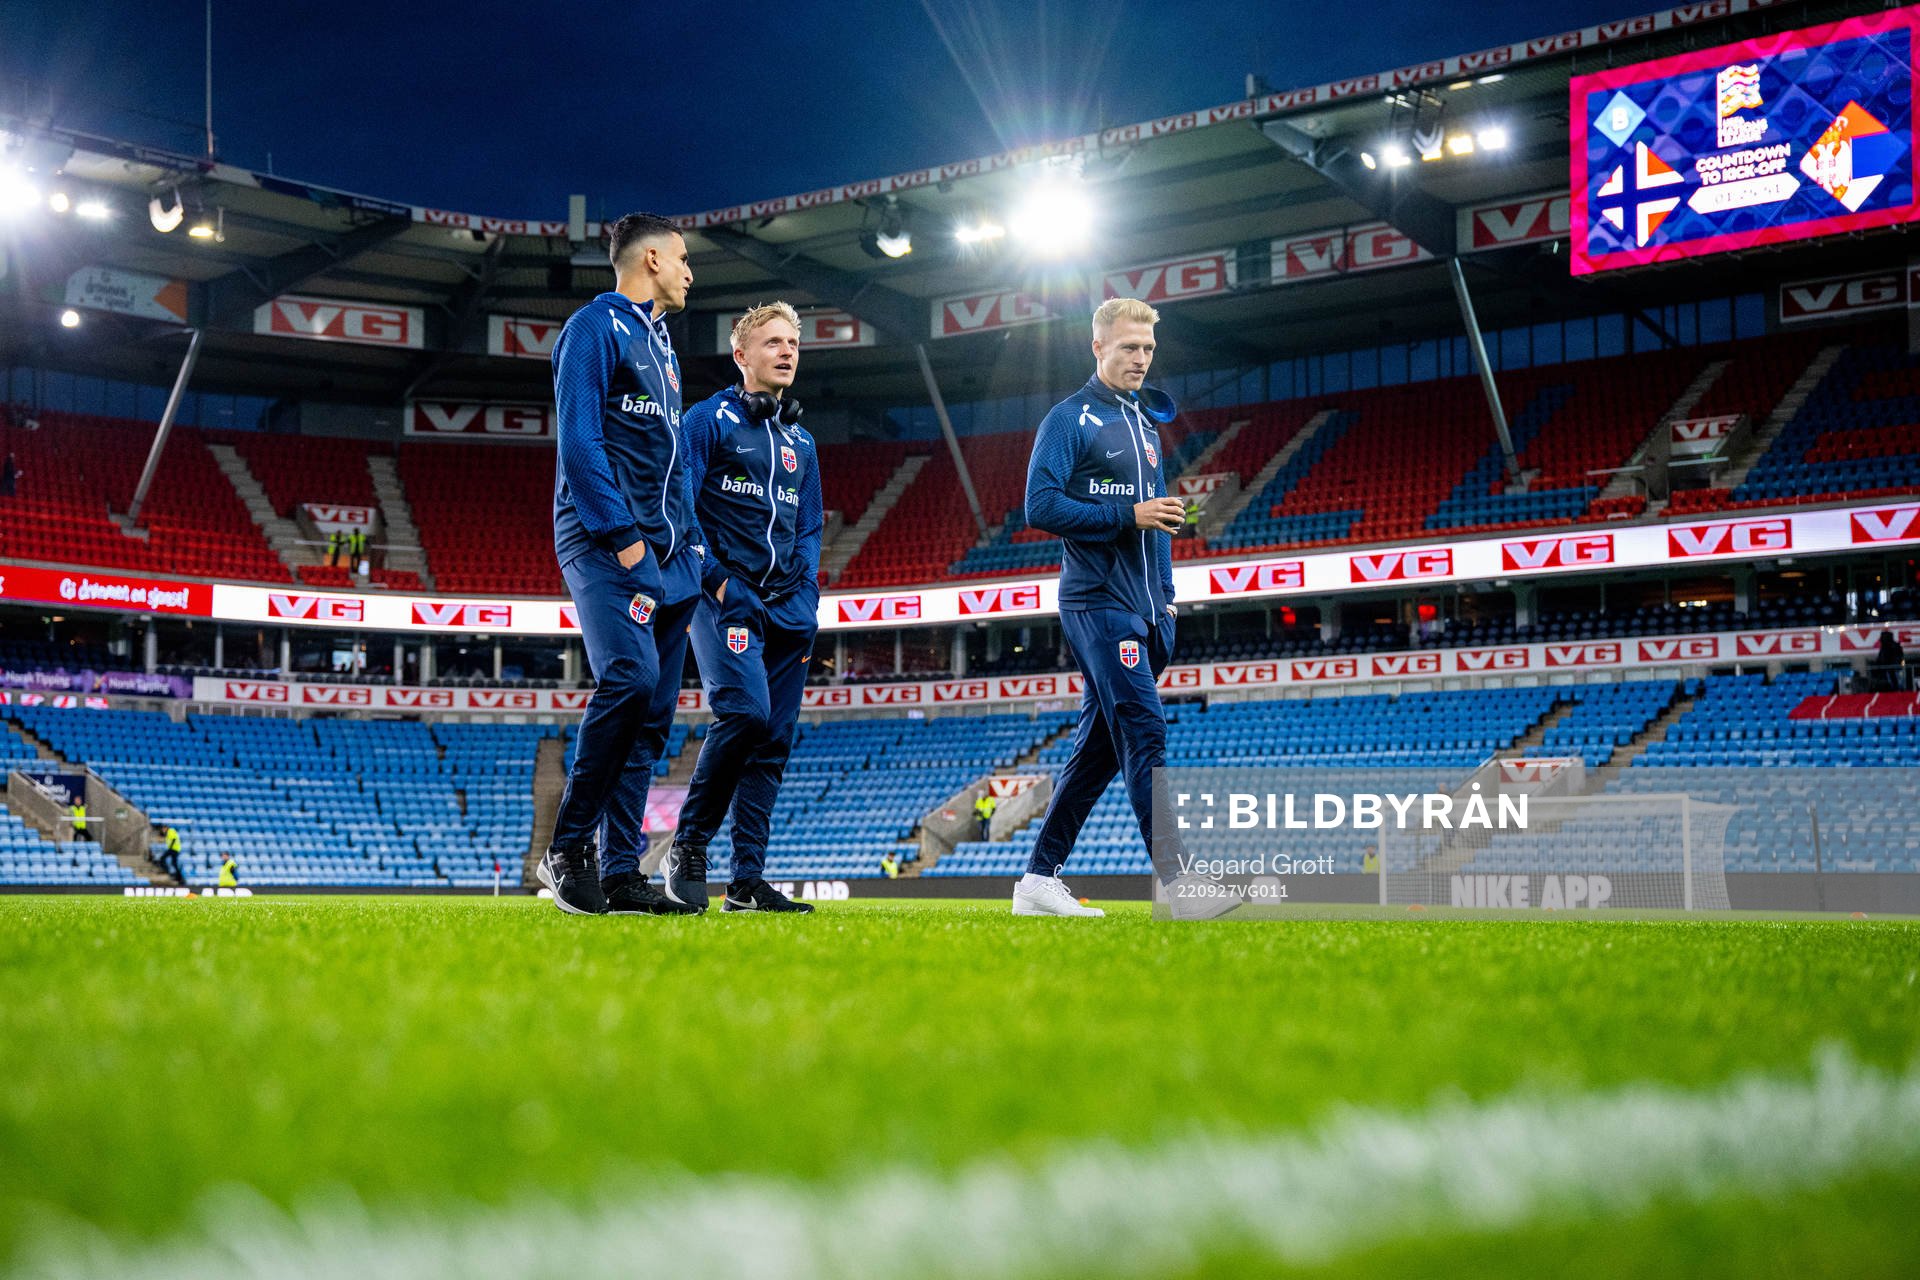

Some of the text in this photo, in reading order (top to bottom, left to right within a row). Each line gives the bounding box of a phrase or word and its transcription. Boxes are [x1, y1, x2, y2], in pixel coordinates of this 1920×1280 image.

[1673, 0, 1732, 24] VG
[1599, 16, 1654, 40] VG
[1527, 32, 1582, 57] VG
[1459, 48, 1511, 71] VG
[1394, 60, 1444, 85] VG
[1330, 76, 1379, 99] VG
[1268, 89, 1317, 110] VG
[1209, 101, 1255, 122] VG
[1612, 107, 1630, 131] B
[1152, 113, 1197, 134] VG
[1098, 125, 1140, 146] VG
[1695, 143, 1791, 172] COUNTDOWN
[891, 171, 930, 189] VG
[941, 160, 980, 179] VG
[1701, 157, 1786, 186] TO KICK-OFF
[797, 190, 833, 208] VG
[843, 181, 881, 199] VG
[425, 208, 469, 228] VG
[706, 208, 742, 225] VG
[751, 200, 788, 217] VG
[480, 216, 528, 235] VG
[1287, 226, 1418, 278] VG
[1104, 255, 1226, 302] VG
[1788, 277, 1898, 313] VG
[271, 300, 410, 344] VG
[944, 294, 1048, 334] VG
[414, 401, 549, 435] VG
[721, 475, 764, 497] bama
[1089, 478, 1135, 496] bama
[309, 506, 368, 524] VG
[1668, 518, 1792, 558] VG
[1502, 534, 1615, 571] VG
[1350, 548, 1453, 583] VG
[1210, 561, 1304, 594] VG
[269, 594, 364, 622] VG
[838, 595, 921, 622] VG
[959, 585, 1040, 614] VG
[412, 602, 511, 627] VG
[1545, 642, 1621, 667] VG
[1638, 636, 1718, 661] VG
[1737, 631, 1821, 656] VG
[1291, 658, 1357, 681] VG
[1372, 653, 1441, 676] VG
[1457, 647, 1529, 671] VG
[1214, 663, 1277, 685] VG
[226, 681, 289, 702] VG
[304, 685, 371, 705] VG
[386, 689, 454, 708] VG
[801, 688, 851, 706] VG
[863, 685, 921, 704] VG
[934, 681, 988, 702] VG
[1000, 677, 1056, 697] VG
[468, 691, 536, 709] VG
[1451, 875, 1529, 908] NIKE
